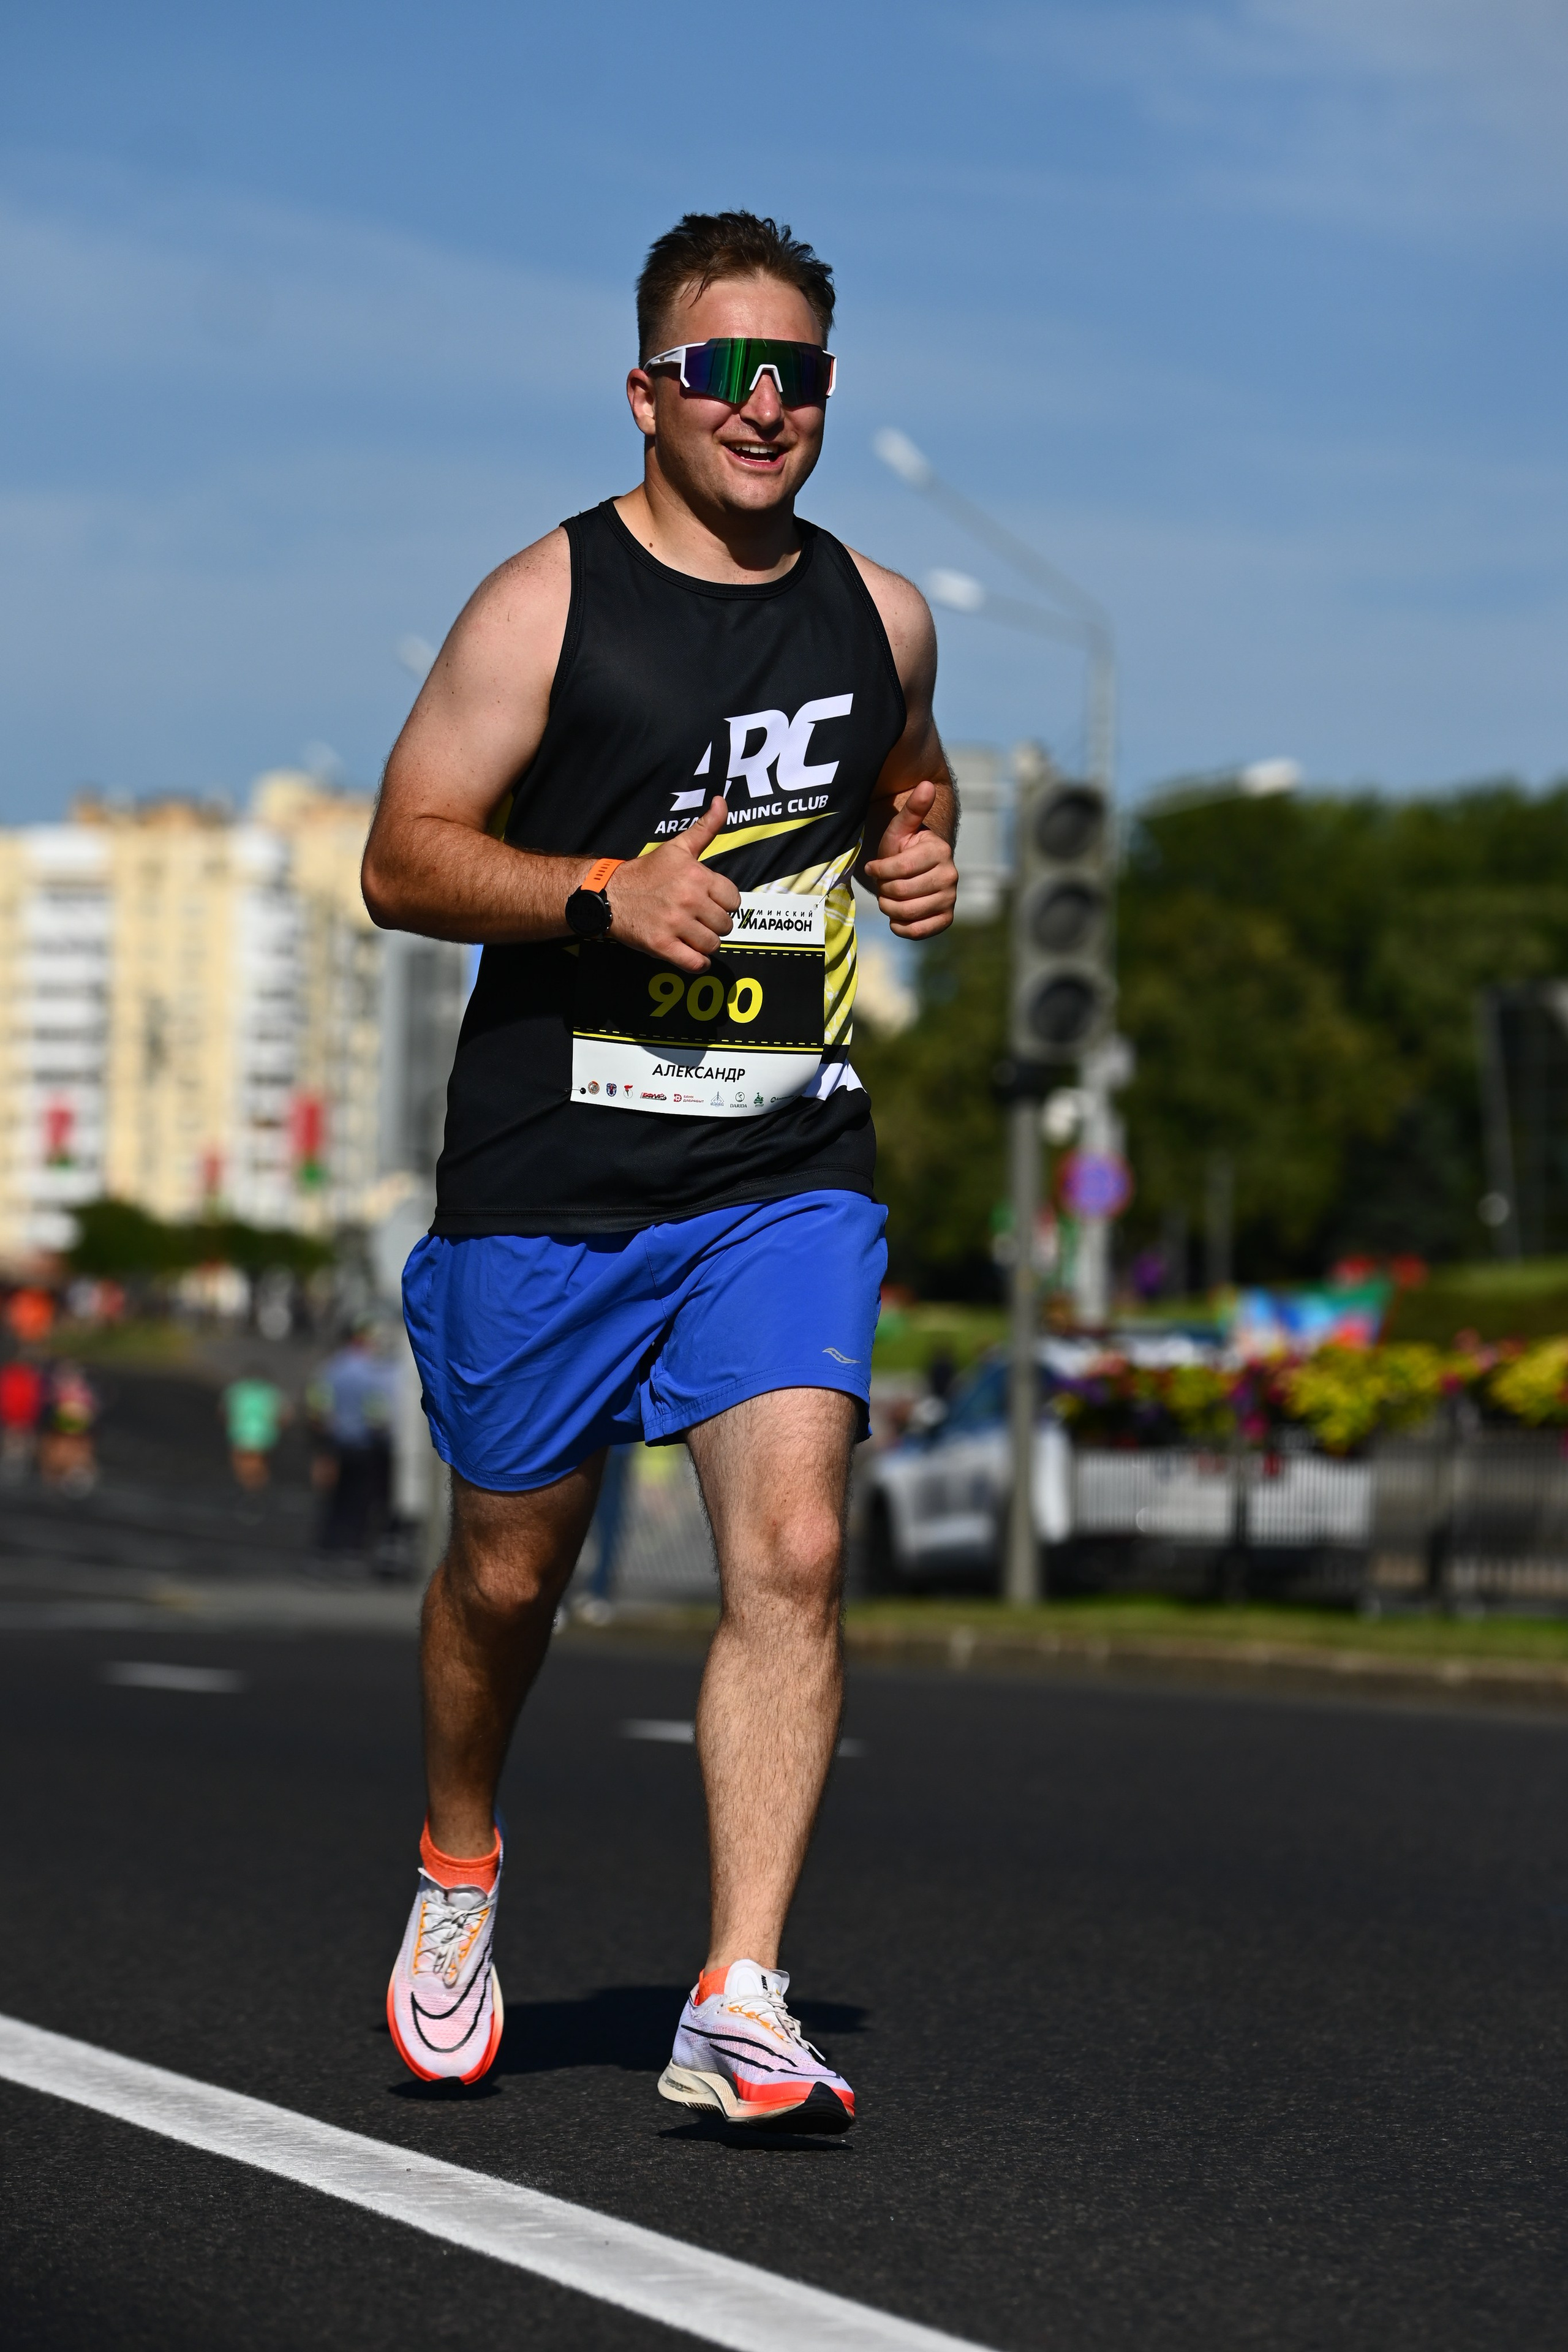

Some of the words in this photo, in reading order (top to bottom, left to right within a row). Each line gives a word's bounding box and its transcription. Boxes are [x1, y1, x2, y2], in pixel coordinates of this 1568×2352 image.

[670, 693, 854, 811] ARC
[726, 802, 782, 825] NNING
[788, 794, 828, 813] CLUB
[743, 918, 812, 932] МАРАФОН
[648, 973, 763, 1023] 900
[652, 1064, 745, 1082] АЛЕКСАНДР
